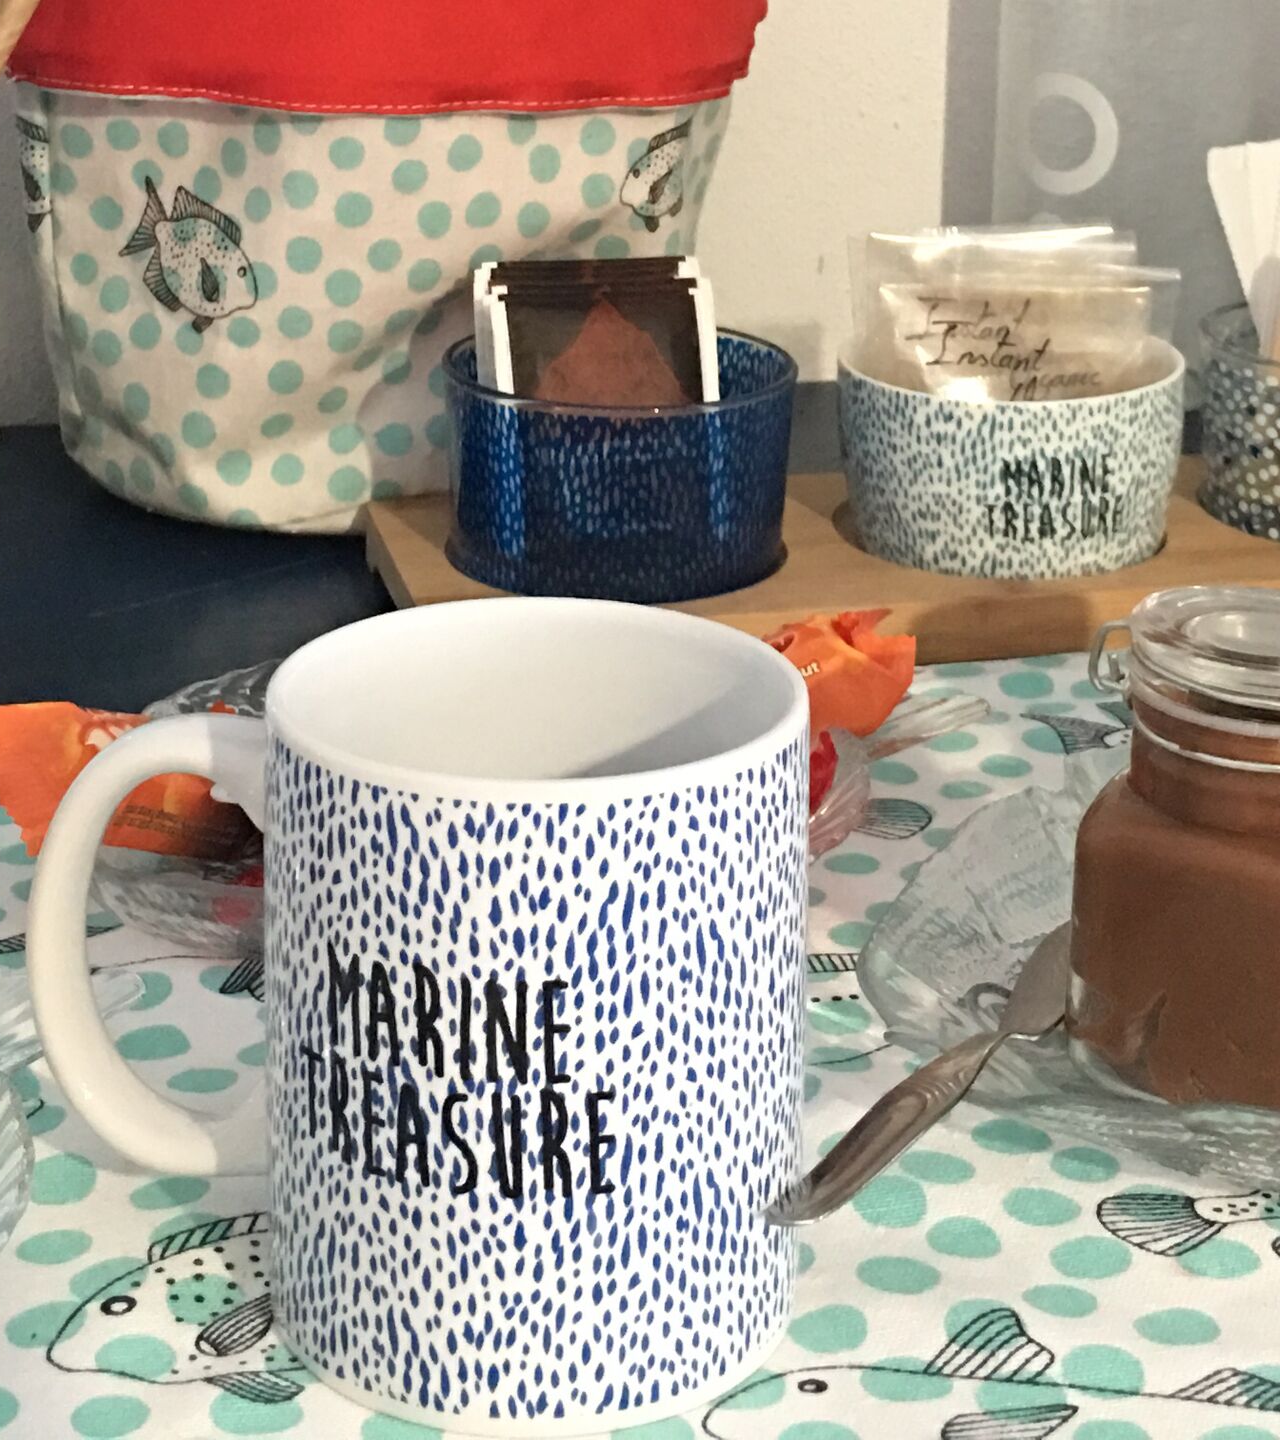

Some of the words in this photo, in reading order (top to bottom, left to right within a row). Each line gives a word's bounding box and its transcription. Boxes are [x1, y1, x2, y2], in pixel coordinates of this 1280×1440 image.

[924, 320, 1052, 372] Instant
[1001, 449, 1113, 503] MARINE
[983, 494, 1124, 543] TREASURE
[327, 939, 572, 1086] MARINE
[300, 1043, 618, 1199] TREASURE
